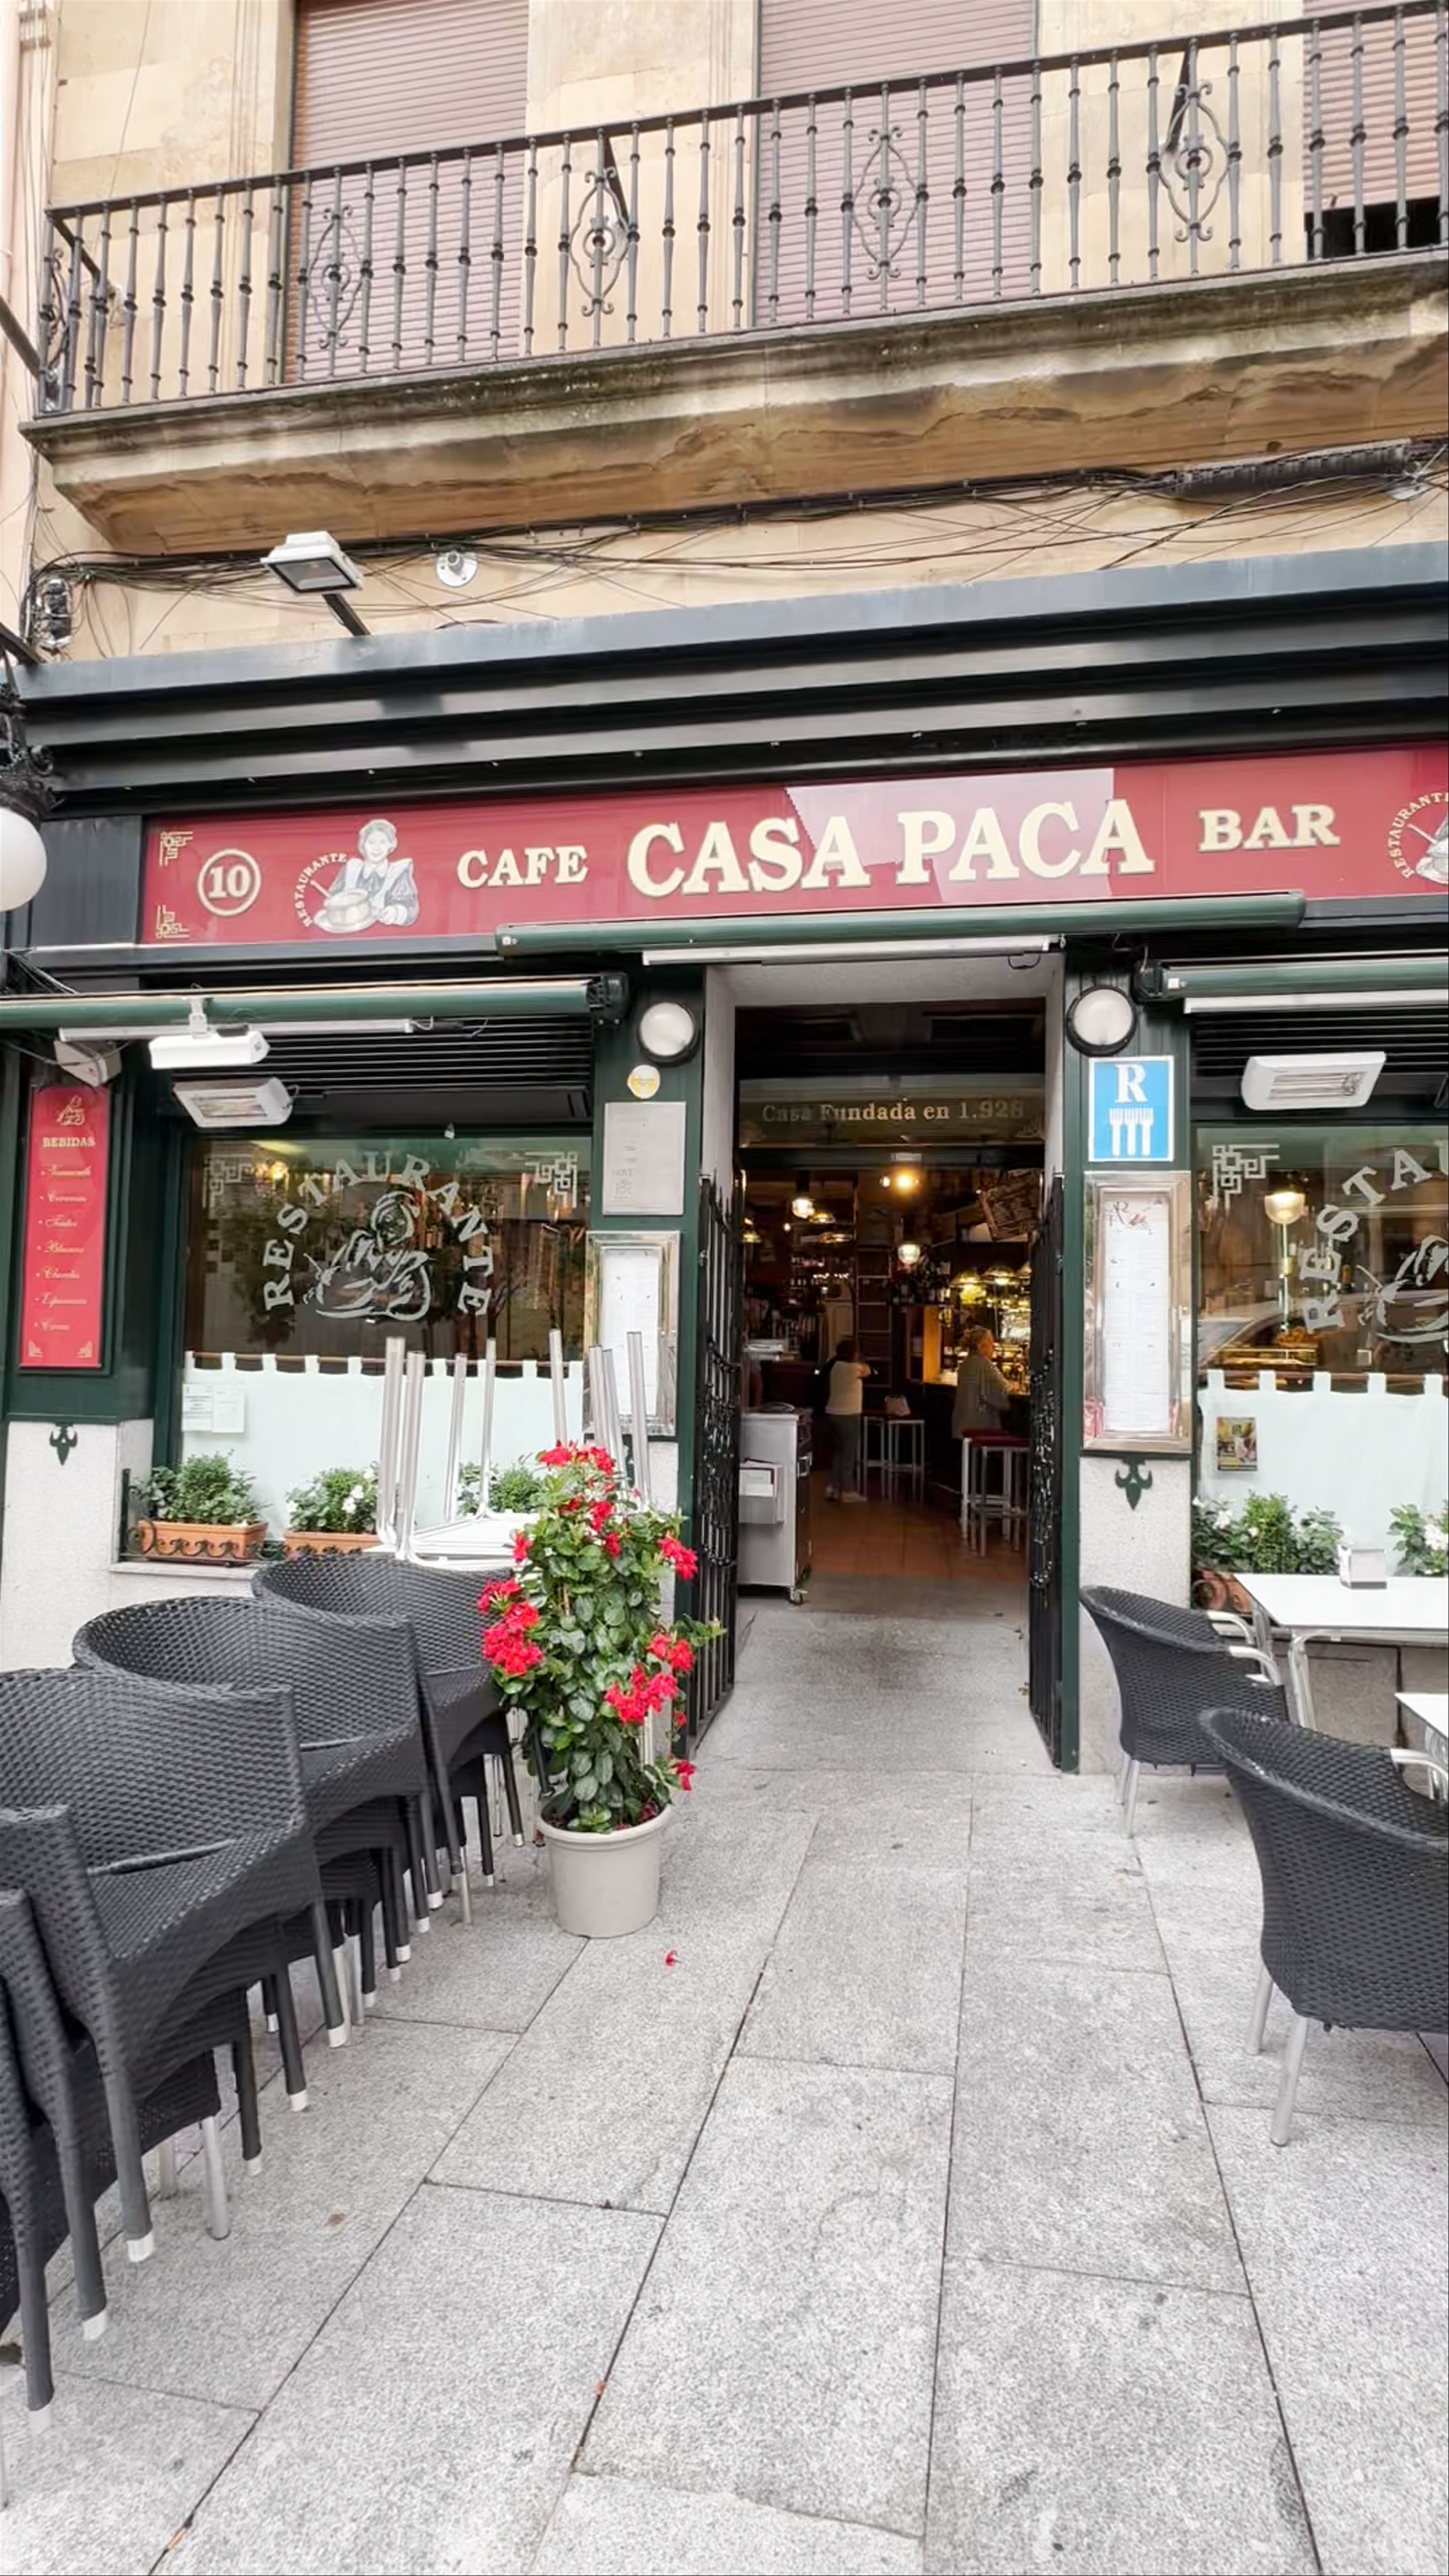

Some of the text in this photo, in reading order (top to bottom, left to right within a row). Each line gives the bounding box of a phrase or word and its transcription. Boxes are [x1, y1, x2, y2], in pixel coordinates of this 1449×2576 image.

[457, 798, 1341, 897] CAFE CASA PACA BAR
[209, 864, 250, 899] 10
[294, 852, 348, 927] RESTAURANTE
[1115, 1064, 1147, 1103] R
[762, 1100, 1024, 1122] Casa Fundada en 1.928
[42, 1137, 96, 1148] BEBIDAS
[263, 1151, 494, 1316] RESTAURANTE
